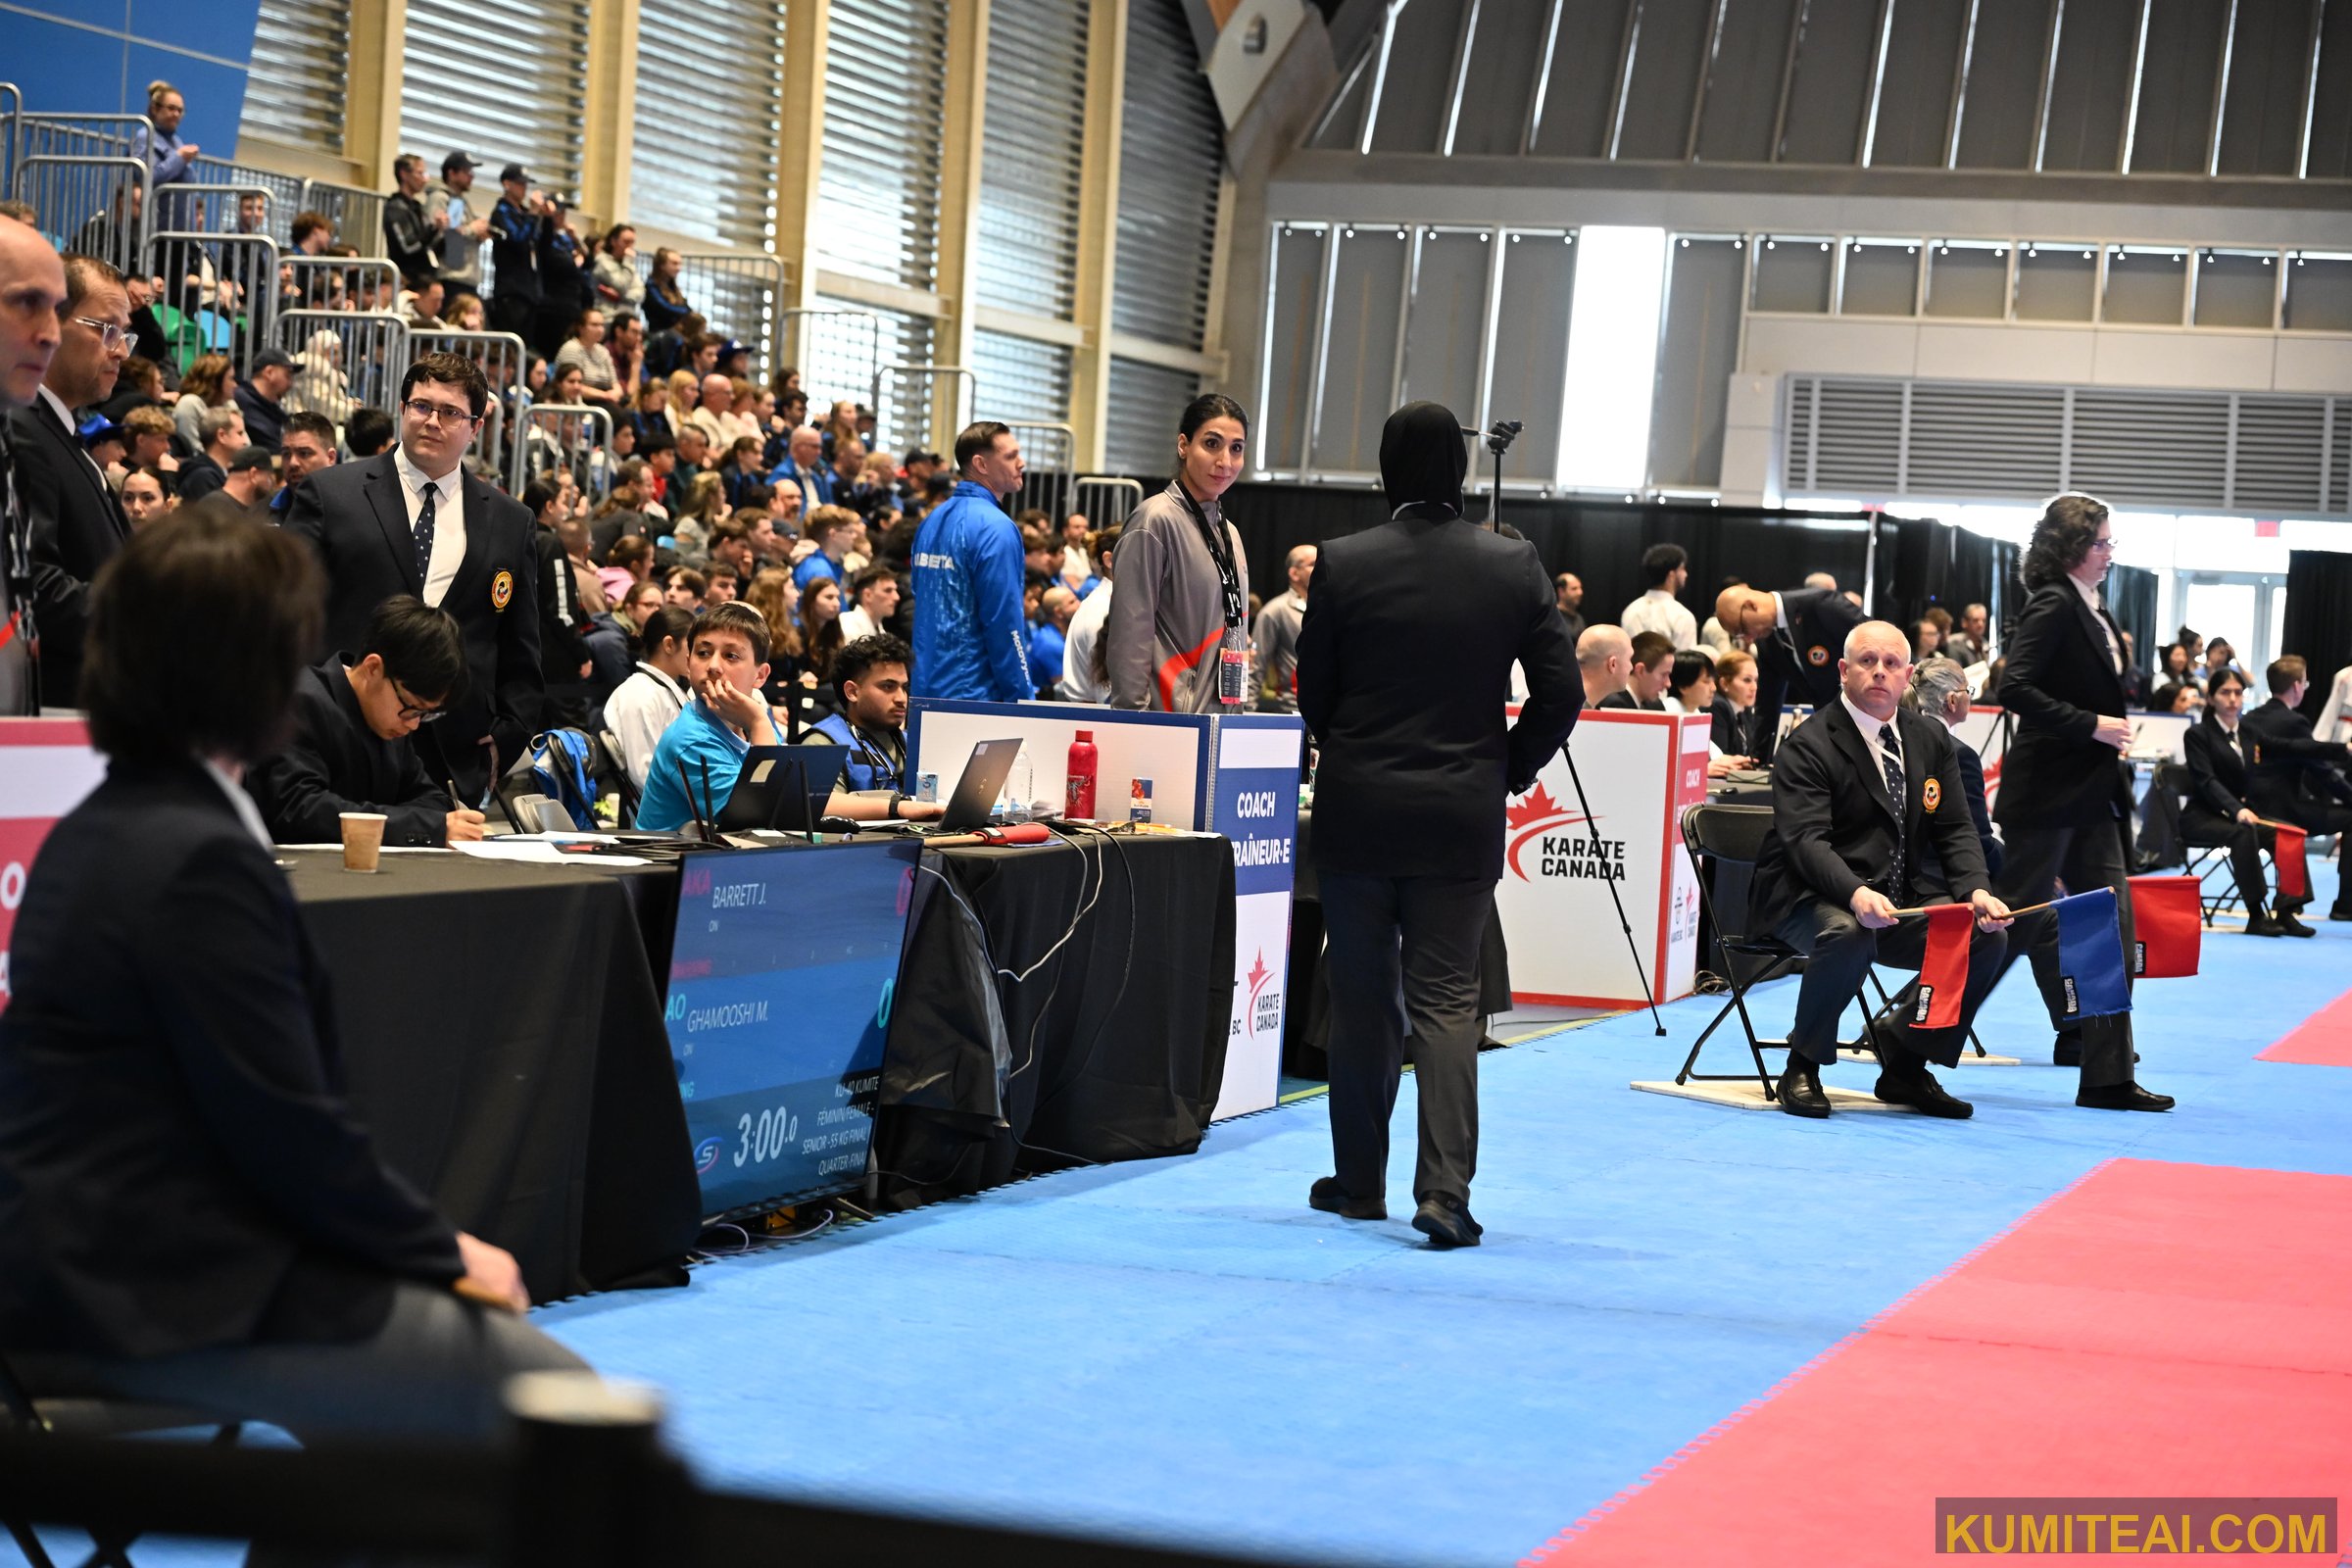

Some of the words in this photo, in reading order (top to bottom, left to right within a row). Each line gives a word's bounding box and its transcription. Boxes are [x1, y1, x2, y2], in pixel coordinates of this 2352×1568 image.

[1237, 792, 1276, 818] COACH
[1543, 836, 1626, 859] KARATE
[1542, 858, 1626, 881] CANADA
[712, 883, 759, 908] BARRETT
[759, 882, 766, 906] J.
[665, 993, 686, 1021] AO
[877, 977, 894, 1029] 0
[1257, 994, 1280, 1012] KARATE
[687, 1003, 757, 1033] GHAMOOSHI
[756, 1000, 768, 1023] M.
[1232, 1018, 1242, 1036] BC
[1256, 1012, 1279, 1032] CANADA
[856, 1075, 880, 1095] KUMITE
[802, 1135, 827, 1155] SENIOR
[839, 1130, 850, 1146] KG
